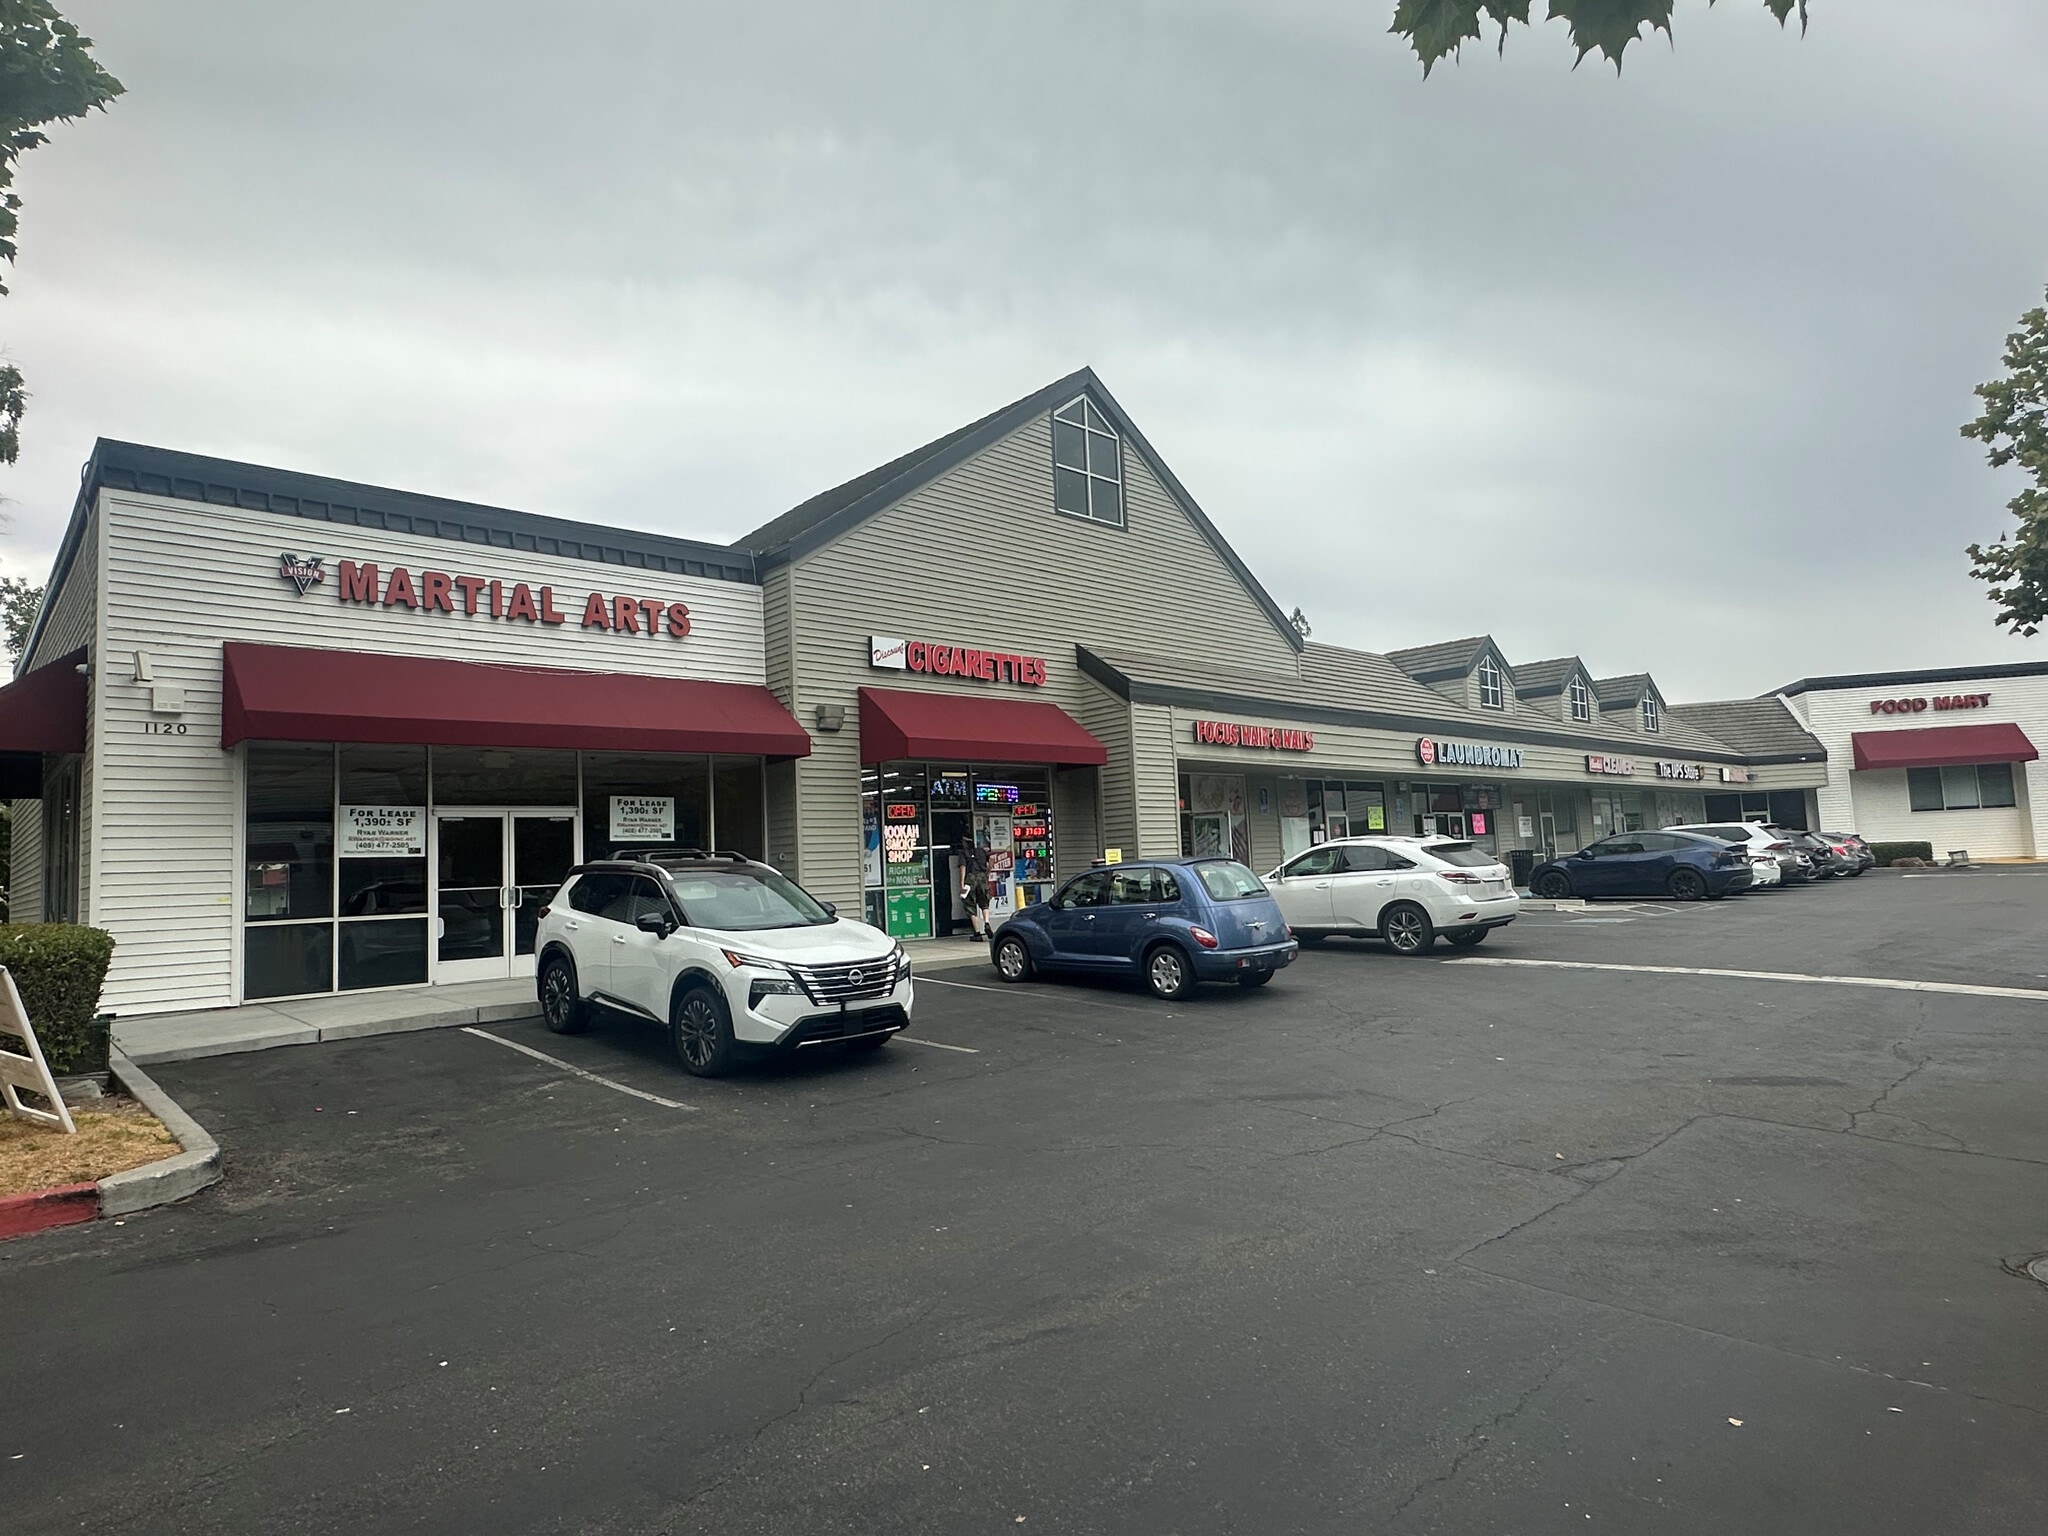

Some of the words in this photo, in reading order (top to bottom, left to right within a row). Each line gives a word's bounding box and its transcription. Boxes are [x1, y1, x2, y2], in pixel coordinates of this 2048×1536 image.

[287, 566, 320, 578] VISION
[339, 560, 565, 624] MARTIAL
[582, 593, 691, 637] ARTS
[907, 641, 1047, 686] CIGARETTES
[1870, 698, 1927, 715] FOOD
[1932, 693, 1991, 711] MART
[145, 723, 187, 734] 1120
[1197, 720, 1239, 745] FOCUS
[1240, 725, 1270, 747] HAIR
[1272, 728, 1281, 748] &
[1282, 729, 1314, 751] NAILS
[1437, 742, 1524, 767] LAUNDROMAT
[1659, 762, 1671, 778] The
[1671, 763, 1684, 779] UPS
[1684, 765, 1699, 780] Store
[349, 808, 374, 817] FOR
[379, 808, 417, 817] LEASE
[888, 805, 915, 818] OPEN
[396, 818, 413, 826] SF
[886, 838, 916, 850] SMOKE
[888, 850, 913, 862] SHOP
[888, 866, 911, 875] RIGHT
